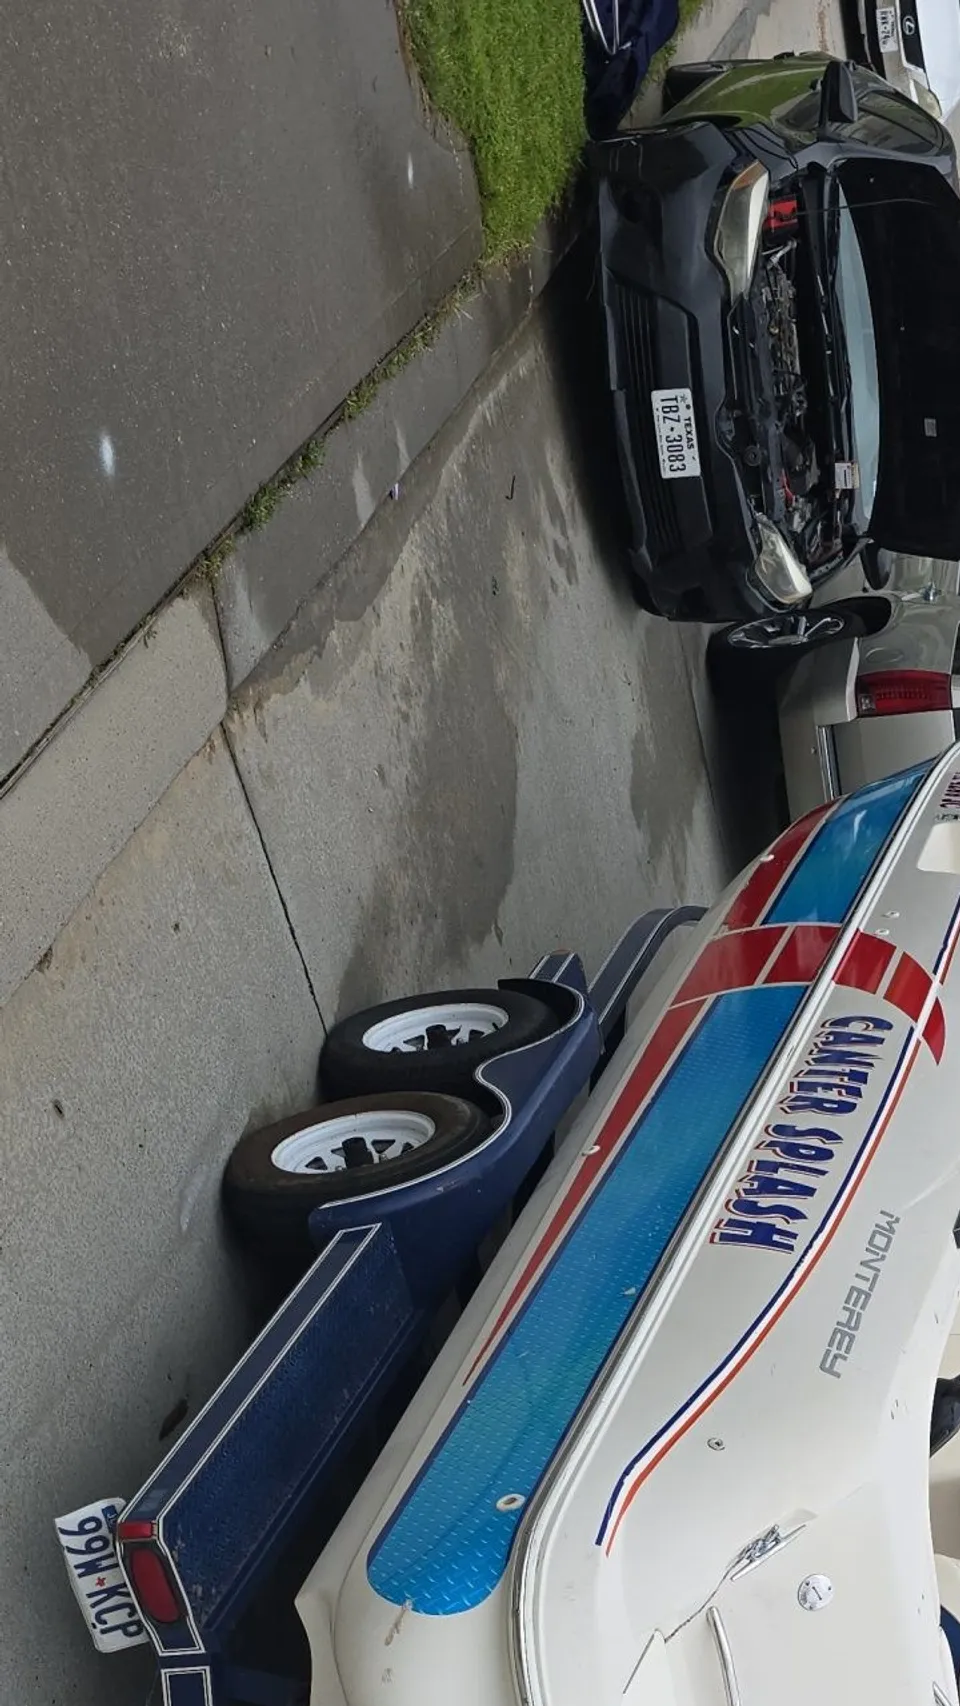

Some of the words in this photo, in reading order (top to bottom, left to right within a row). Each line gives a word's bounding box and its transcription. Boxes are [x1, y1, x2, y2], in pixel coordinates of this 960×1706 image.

[684, 416, 695, 450] TEXAS
[778, 1016, 894, 1116] CANTER
[708, 1123, 844, 1255] SPLASH
[818, 1209, 901, 1379] MONTEREY
